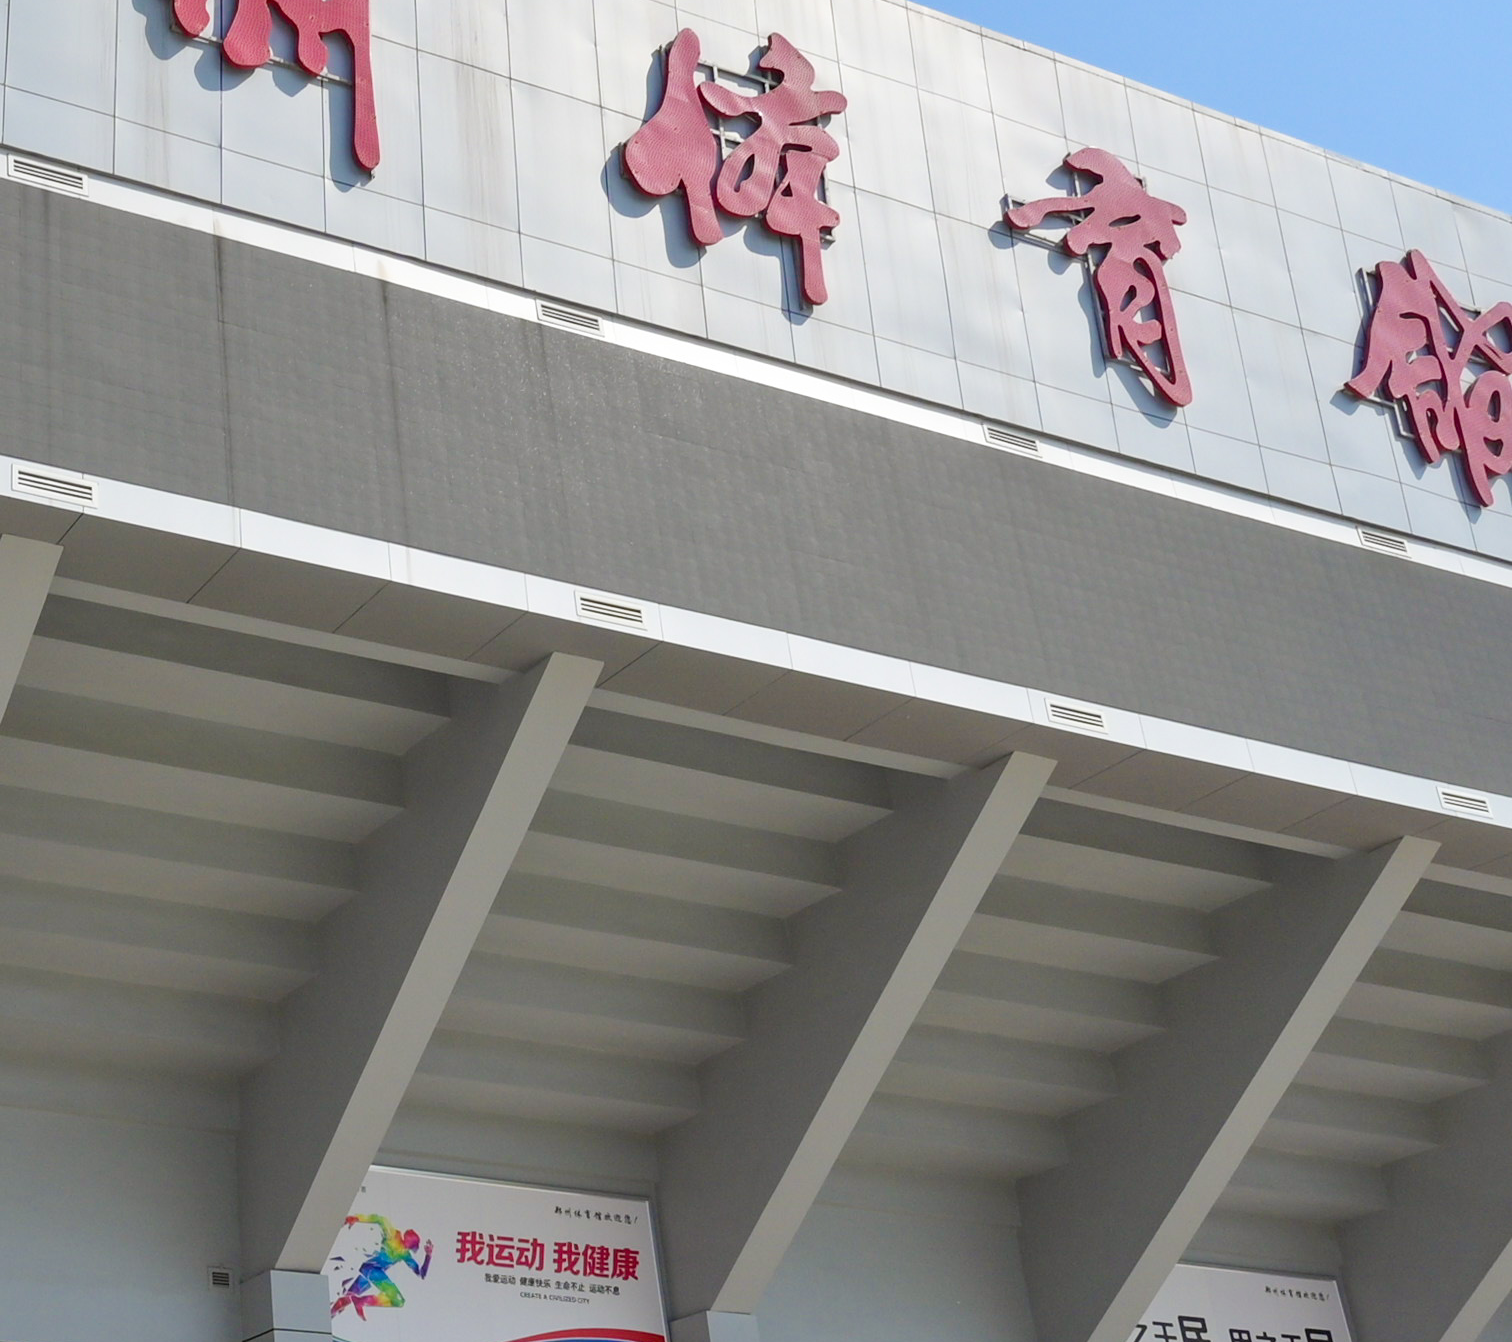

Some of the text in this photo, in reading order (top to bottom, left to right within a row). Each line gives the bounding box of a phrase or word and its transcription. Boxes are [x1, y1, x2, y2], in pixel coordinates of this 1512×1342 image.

[456, 1230, 640, 1282] 我运动 我健康
[485, 1273, 621, 1296] 我爱运动 健康快乐 生命不止 运动不息
